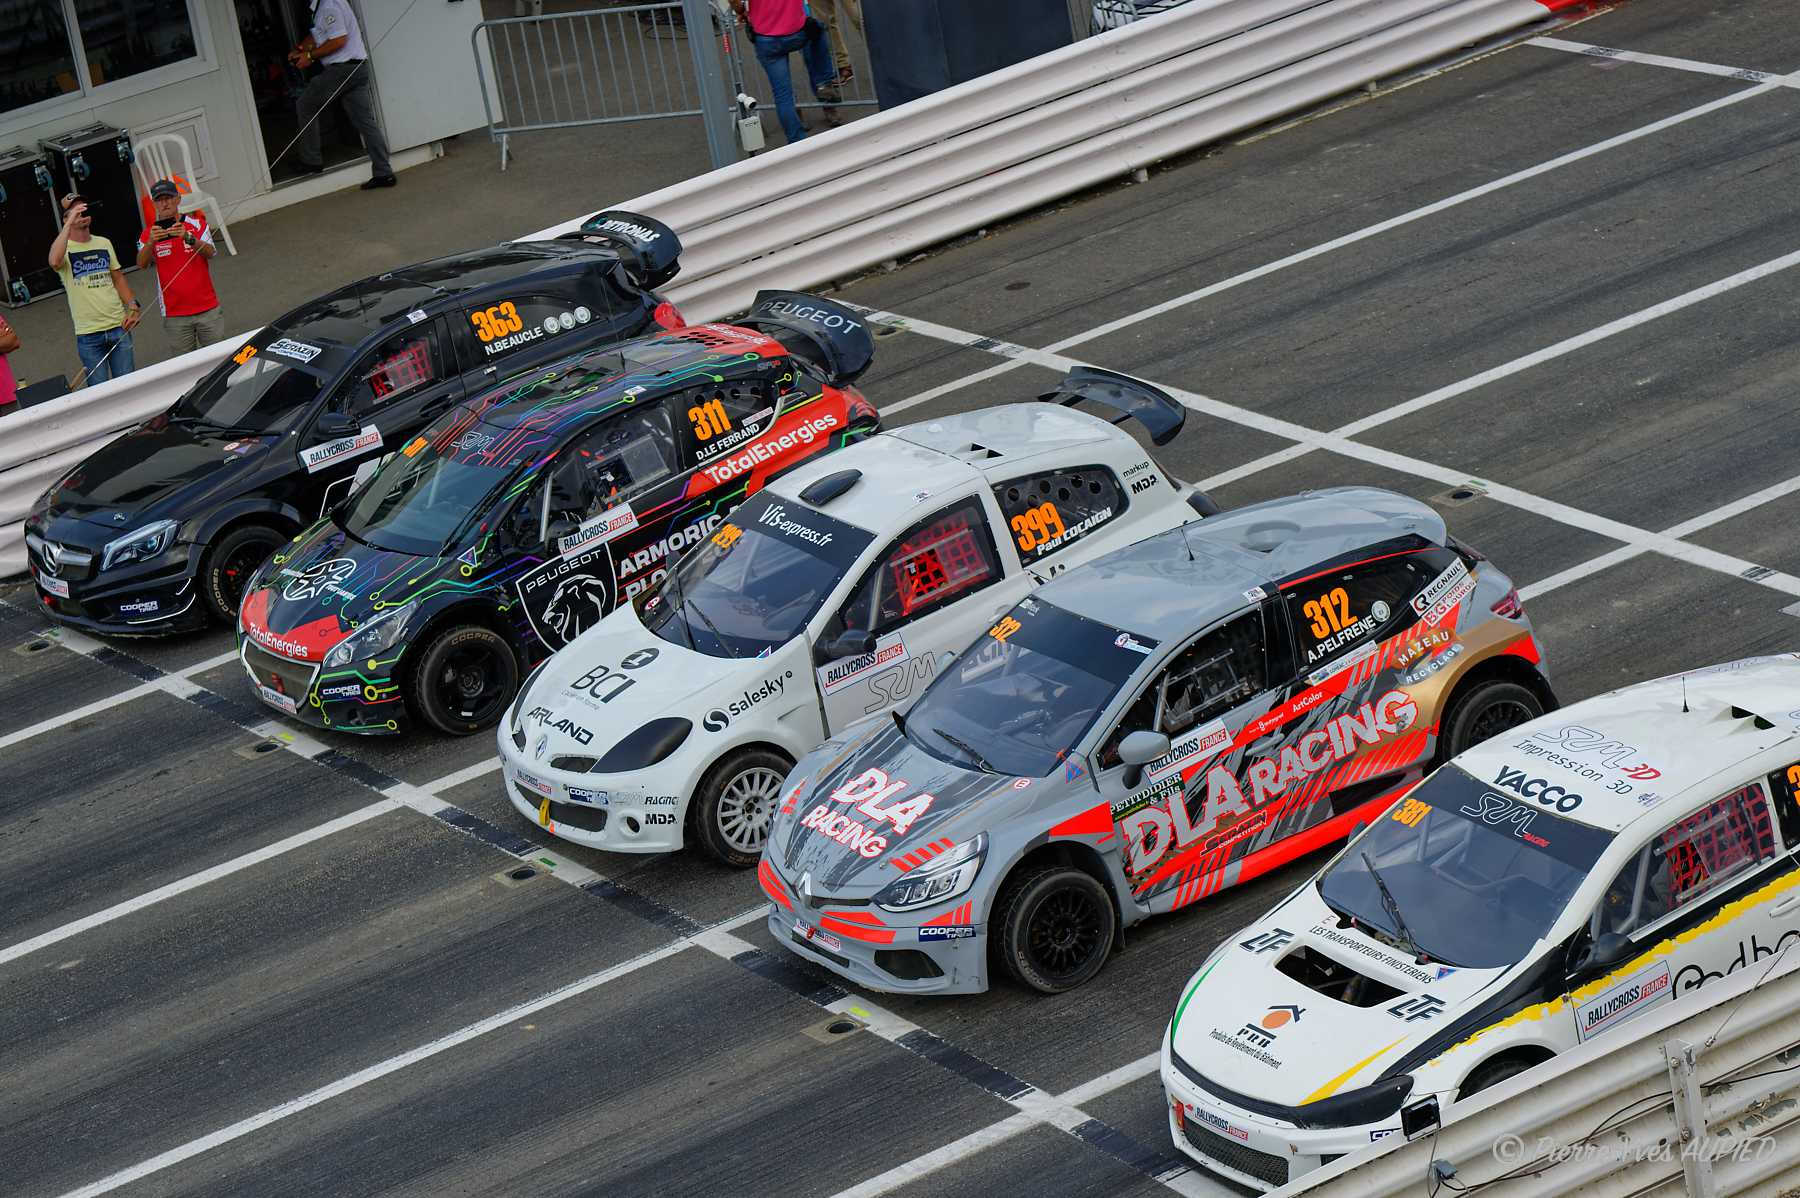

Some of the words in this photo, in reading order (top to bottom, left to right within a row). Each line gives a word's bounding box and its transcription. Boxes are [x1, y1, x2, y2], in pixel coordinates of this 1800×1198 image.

[472, 301, 523, 342] 363
[760, 301, 862, 335] PEUGEOT
[484, 326, 544, 356] N.BEAUCLE
[688, 398, 732, 441] 311
[718, 423, 760, 451] FERRAND
[310, 438, 355, 463] RALLYCROSS
[355, 432, 379, 449] FRANCE
[704, 414, 838, 485] TotalEnergies
[1122, 461, 1150, 478] markup
[564, 521, 608, 550] RALLYCROSS
[608, 513, 634, 532] FRANCE
[620, 507, 732, 579] ARMORIC
[759, 503, 833, 547] Vis-express.fr
[1010, 502, 1066, 552] 399
[1037, 537, 1062, 556] Paul
[526, 550, 601, 594] PEUGEOT
[1427, 562, 1463, 598] REGNAULT
[1303, 587, 1358, 639] 312
[250, 622, 308, 657] TotalEnergies
[1307, 615, 1377, 664] A.PELFRENE
[1398, 631, 1449, 666] MAZEAU
[828, 652, 876, 684] RALLYCROSS
[877, 643, 903, 664] FRANCE
[1406, 645, 1460, 684] RECYCLAGE
[323, 685, 360, 696] COOPER
[570, 665, 637, 704] BCI
[729, 675, 784, 718] Salesky
[1292, 690, 1323, 712] ArtColor
[528, 706, 594, 746] ARLAND
[1150, 738, 1199, 774] RALLYCROSS
[1200, 728, 1226, 750] FRANCE
[1513, 739, 1604, 782] Impression
[1605, 780, 1633, 795] 3D
[1120, 765, 1251, 875] DLA
[1248, 690, 1418, 806] RACING
[1493, 765, 1583, 813] YACCO
[1620, 763, 1661, 781] 3D
[830, 768, 934, 835] DLA
[800, 804, 887, 858] RACING
[919, 927, 976, 937] COOPER
[1239, 927, 1295, 955] LTF
[1309, 925, 1325, 938] LES
[1324, 928, 1387, 961] TRANSPORTEURS
[1382, 955, 1434, 984] FINISTERIENS
[1387, 993, 1446, 1023] LTF
[1588, 985, 1640, 1026] RALLYCROSS
[1641, 972, 1668, 1001] FRANCE
[1196, 1107, 1229, 1130] RALLYCROSS
[1227, 1125, 1249, 1141] FRANCE
